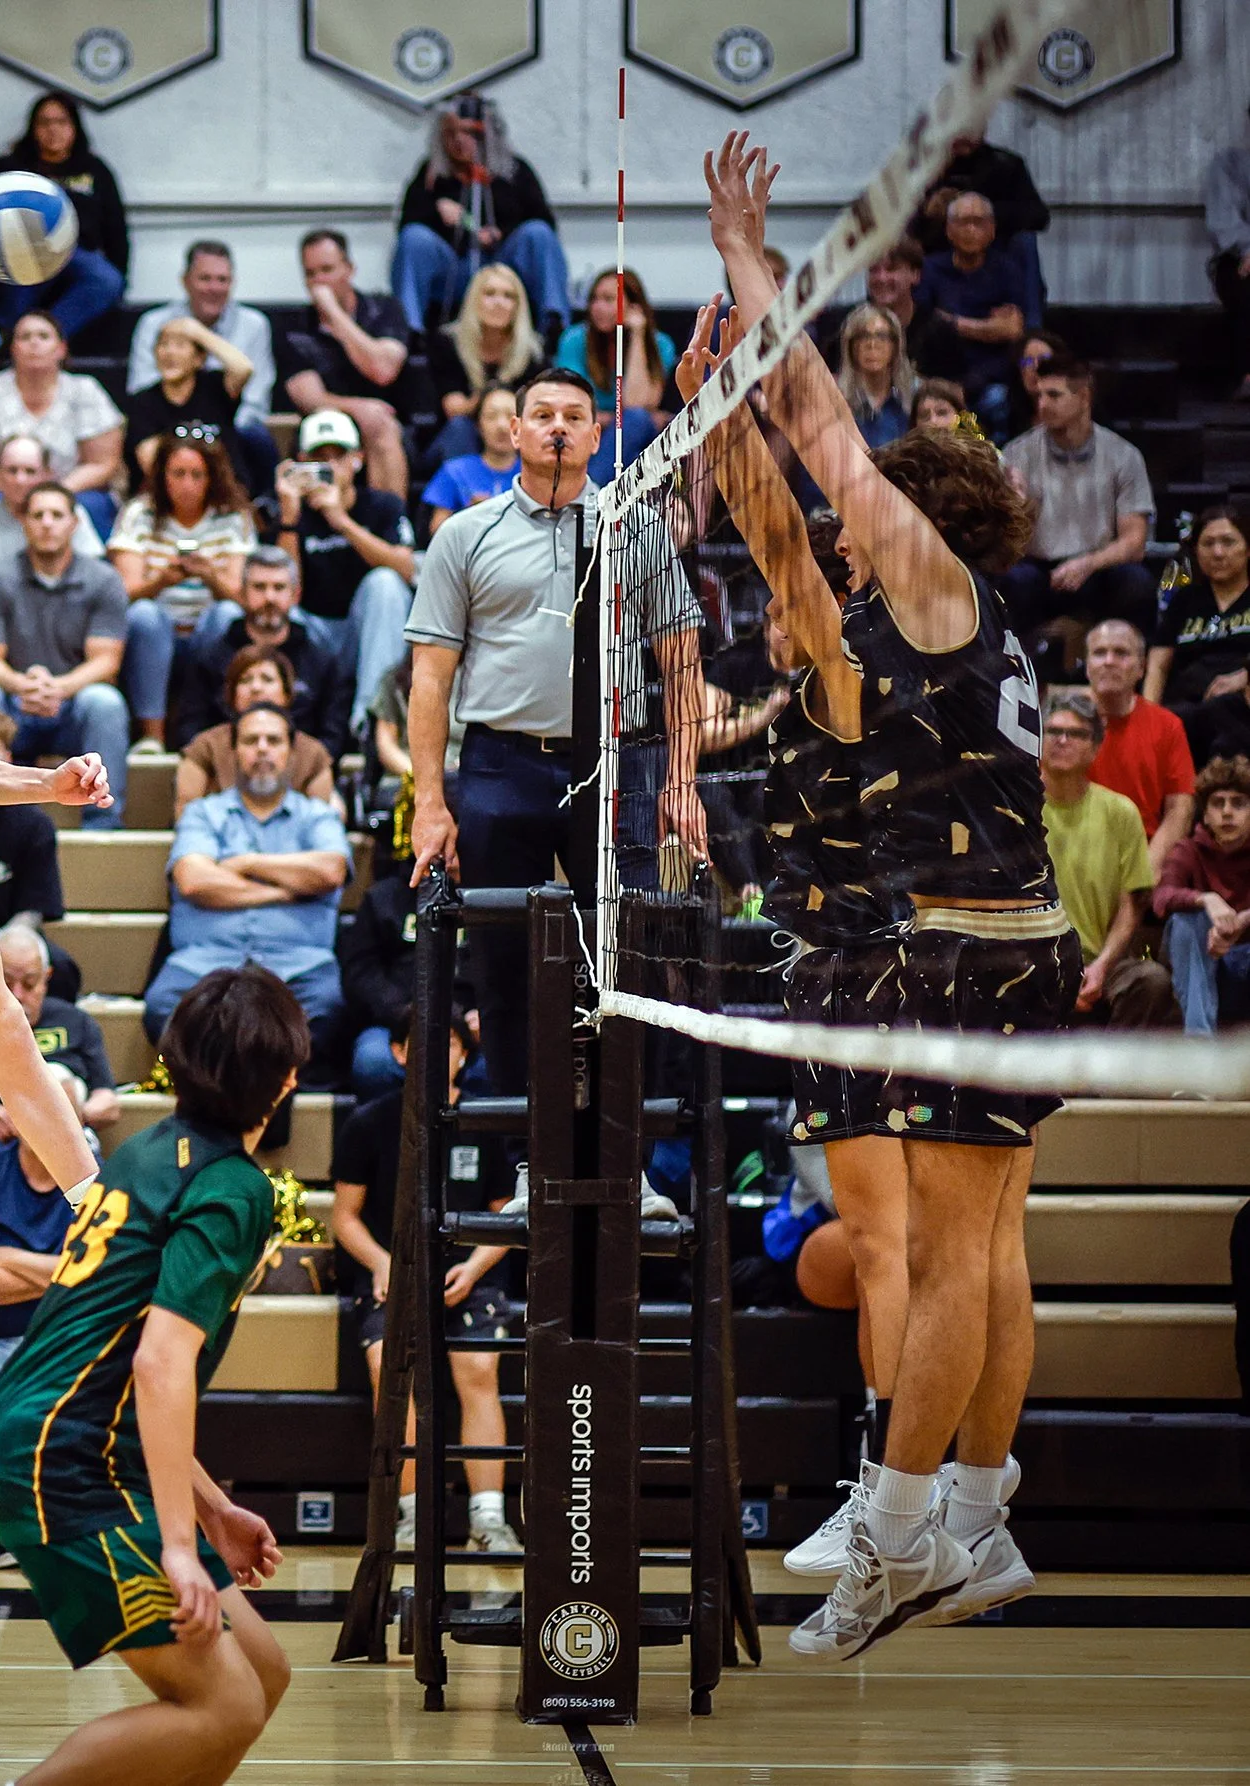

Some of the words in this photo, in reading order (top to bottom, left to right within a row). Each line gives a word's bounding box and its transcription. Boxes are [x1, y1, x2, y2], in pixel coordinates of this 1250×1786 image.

[93, 46, 111, 68] C
[414, 46, 432, 68] C
[735, 46, 752, 68] C
[1055, 47, 1075, 69] C
[997, 629, 1043, 762] 2
[566, 1384, 595, 1471] sports
[565, 1477, 594, 1584] imports
[551, 1604, 608, 1624] CANYON
[565, 1623, 592, 1658] C
[548, 1654, 611, 1677] VOLLEYBALL
[542, 1697, 568, 1708] (800)
[569, 1698, 615, 1708] 556-3198
